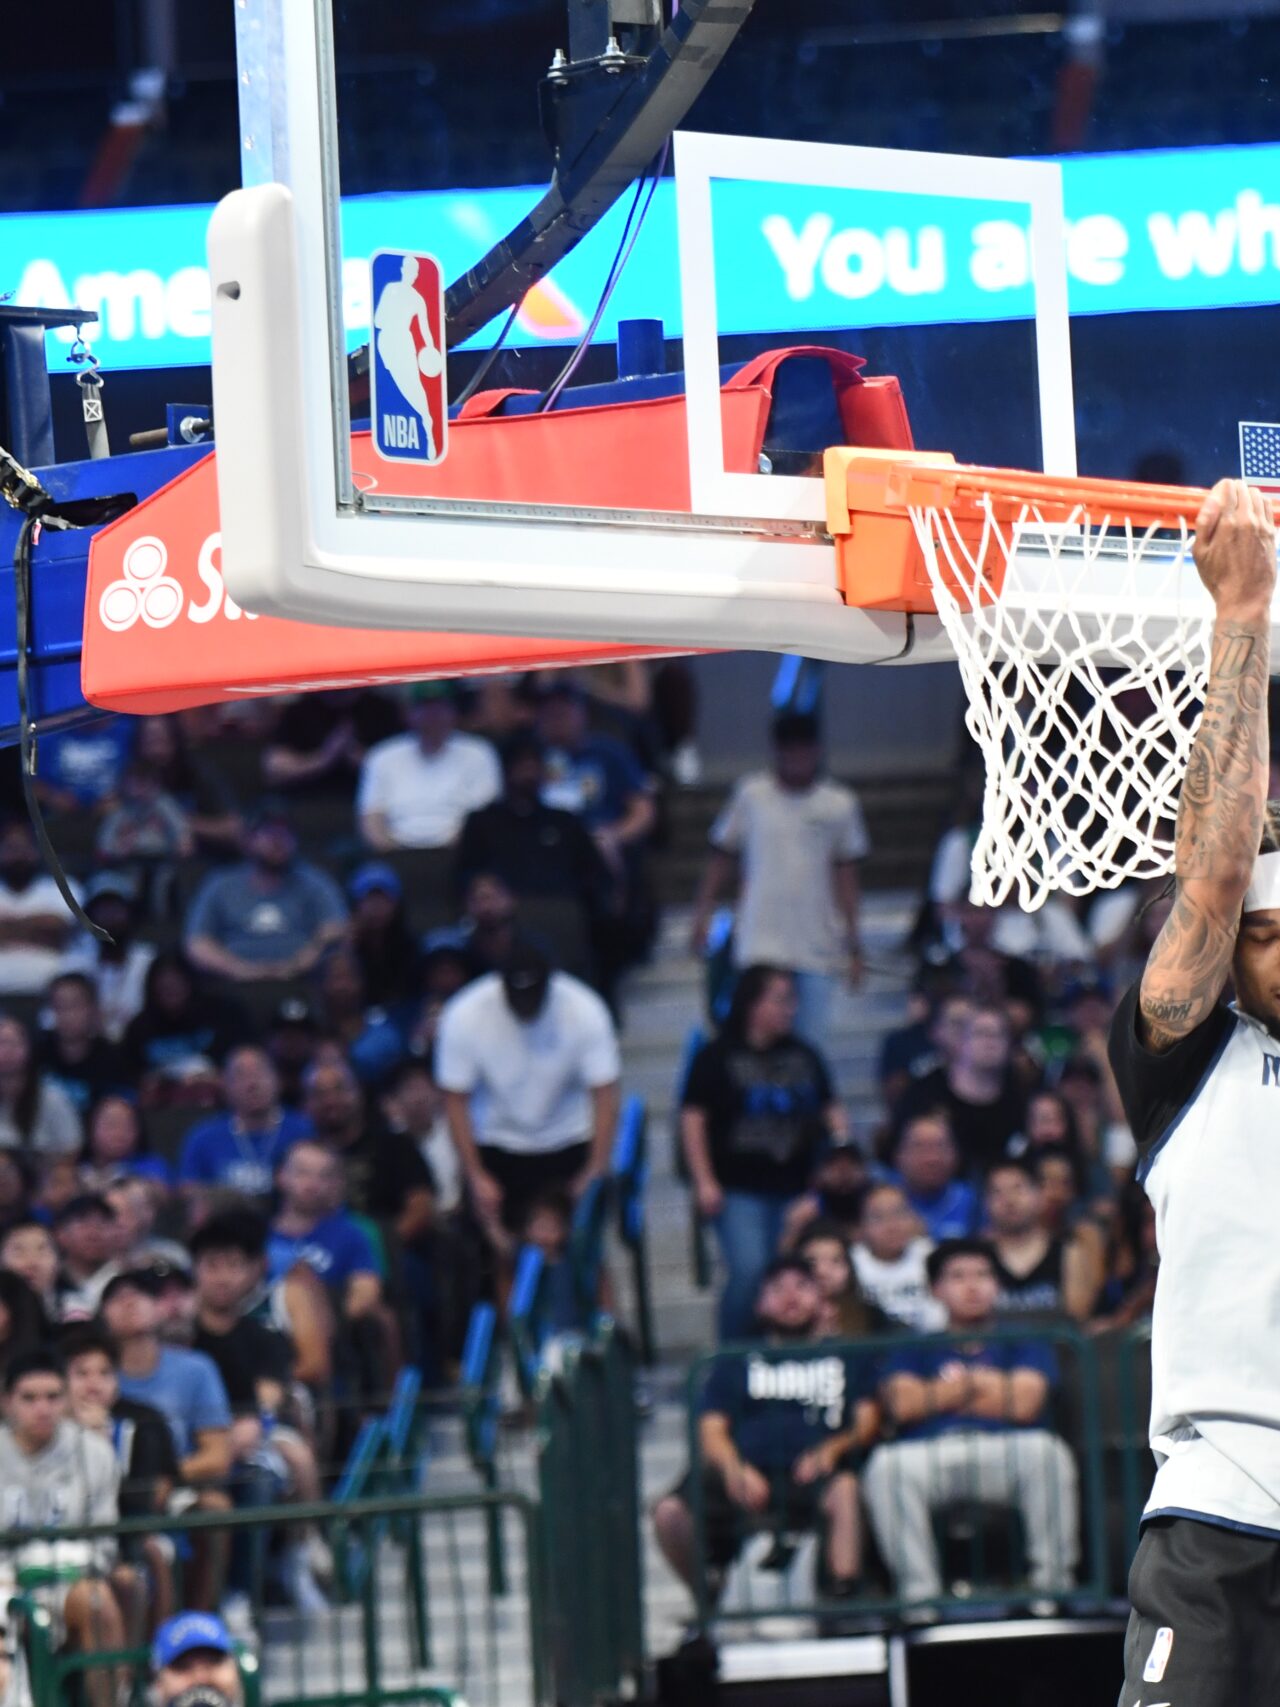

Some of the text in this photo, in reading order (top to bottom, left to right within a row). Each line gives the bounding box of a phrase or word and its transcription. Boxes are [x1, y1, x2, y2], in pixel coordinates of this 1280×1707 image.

[762, 212, 946, 302] You
[970, 214, 1129, 292] ae
[383, 414, 420, 450] NBA
